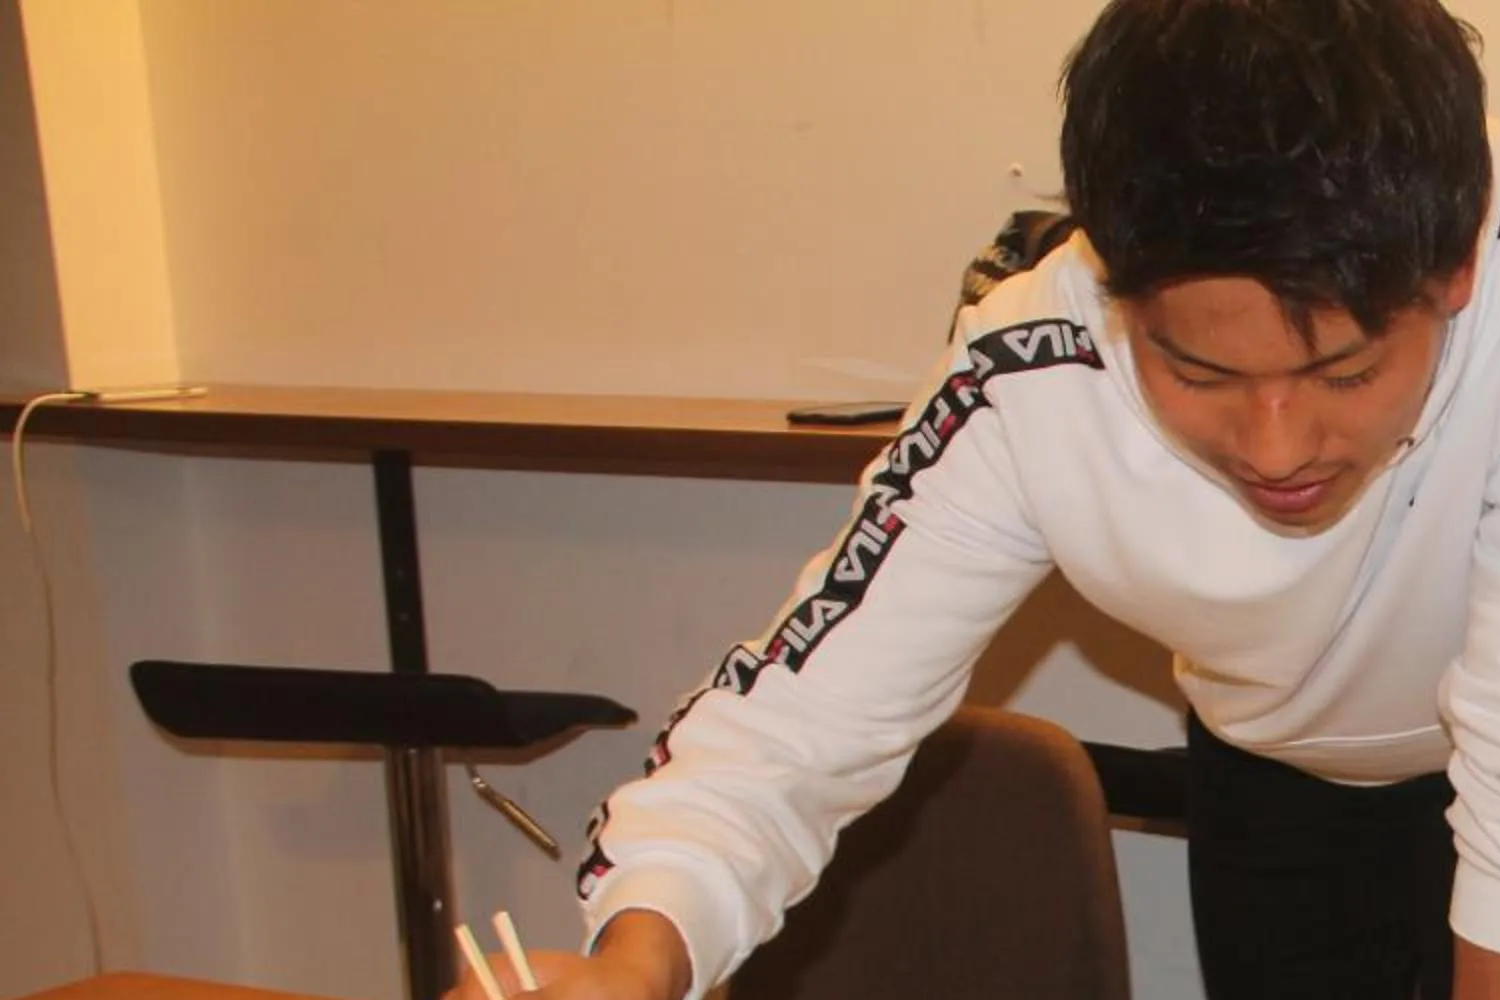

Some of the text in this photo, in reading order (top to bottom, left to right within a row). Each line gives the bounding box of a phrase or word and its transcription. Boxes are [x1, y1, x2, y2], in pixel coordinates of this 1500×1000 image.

[891, 398, 956, 474] FILA
[768, 600, 848, 664] FILA
[717, 647, 769, 692] ILA
